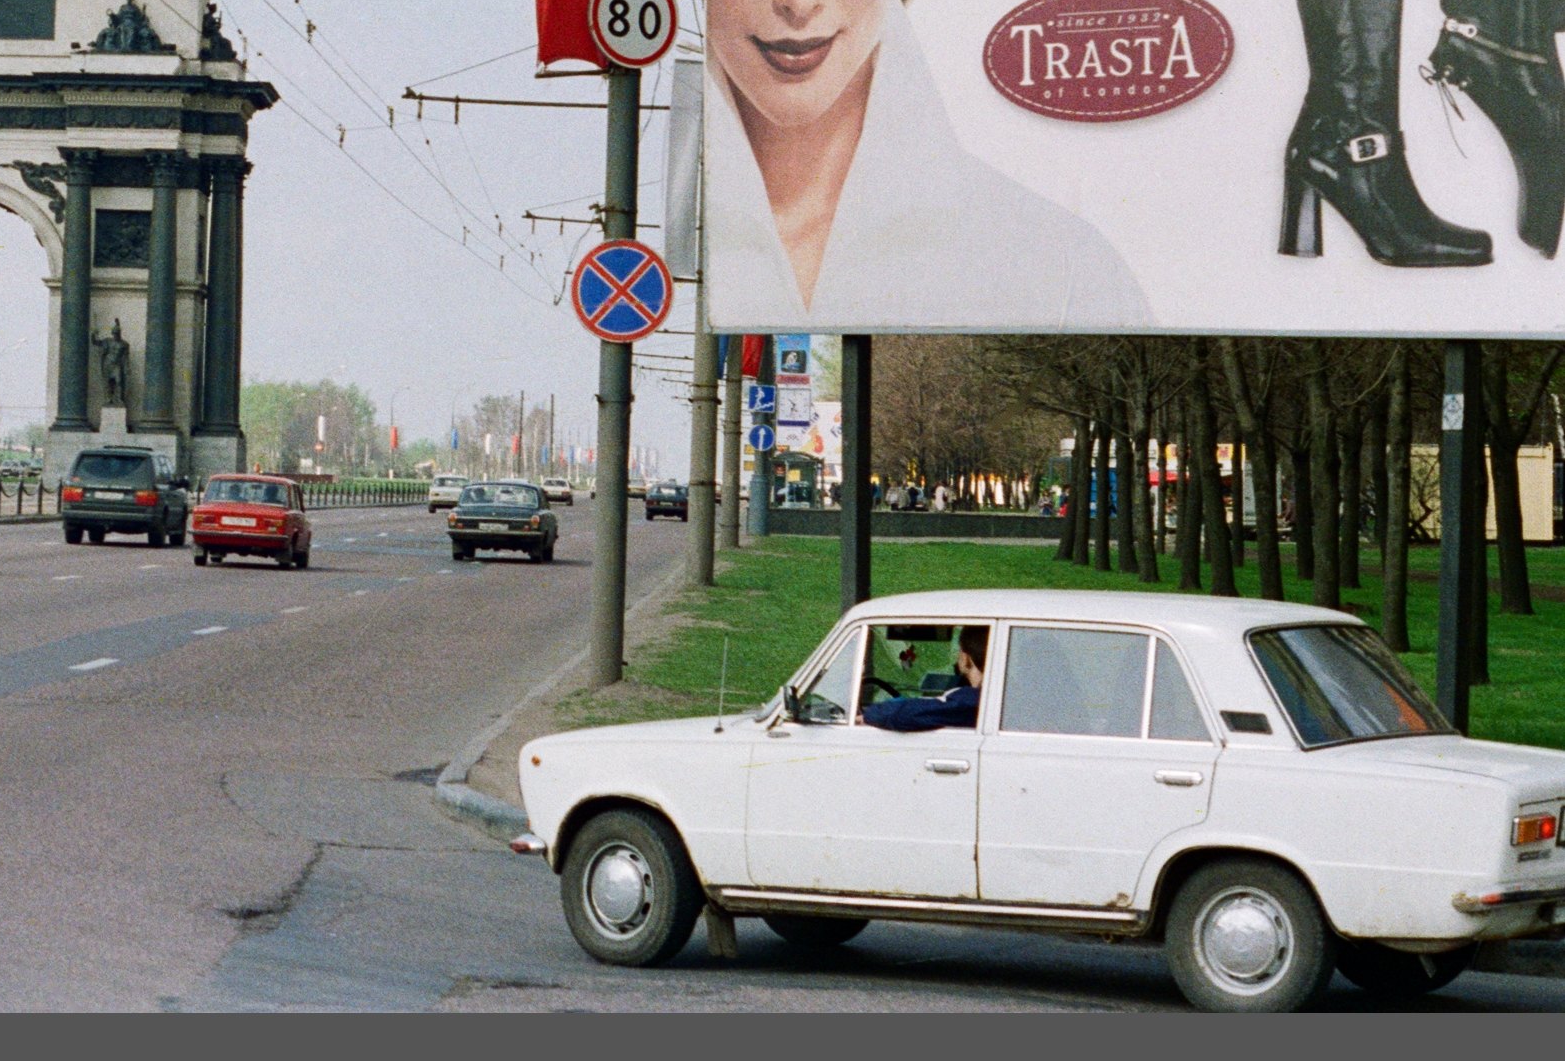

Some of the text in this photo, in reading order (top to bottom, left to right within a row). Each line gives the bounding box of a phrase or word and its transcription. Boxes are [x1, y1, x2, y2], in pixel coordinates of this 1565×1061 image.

[1056, 15, 1106, 28] since
[1010, 16, 1201, 86] TRASTA
[1043, 84, 1168, 99] of London
